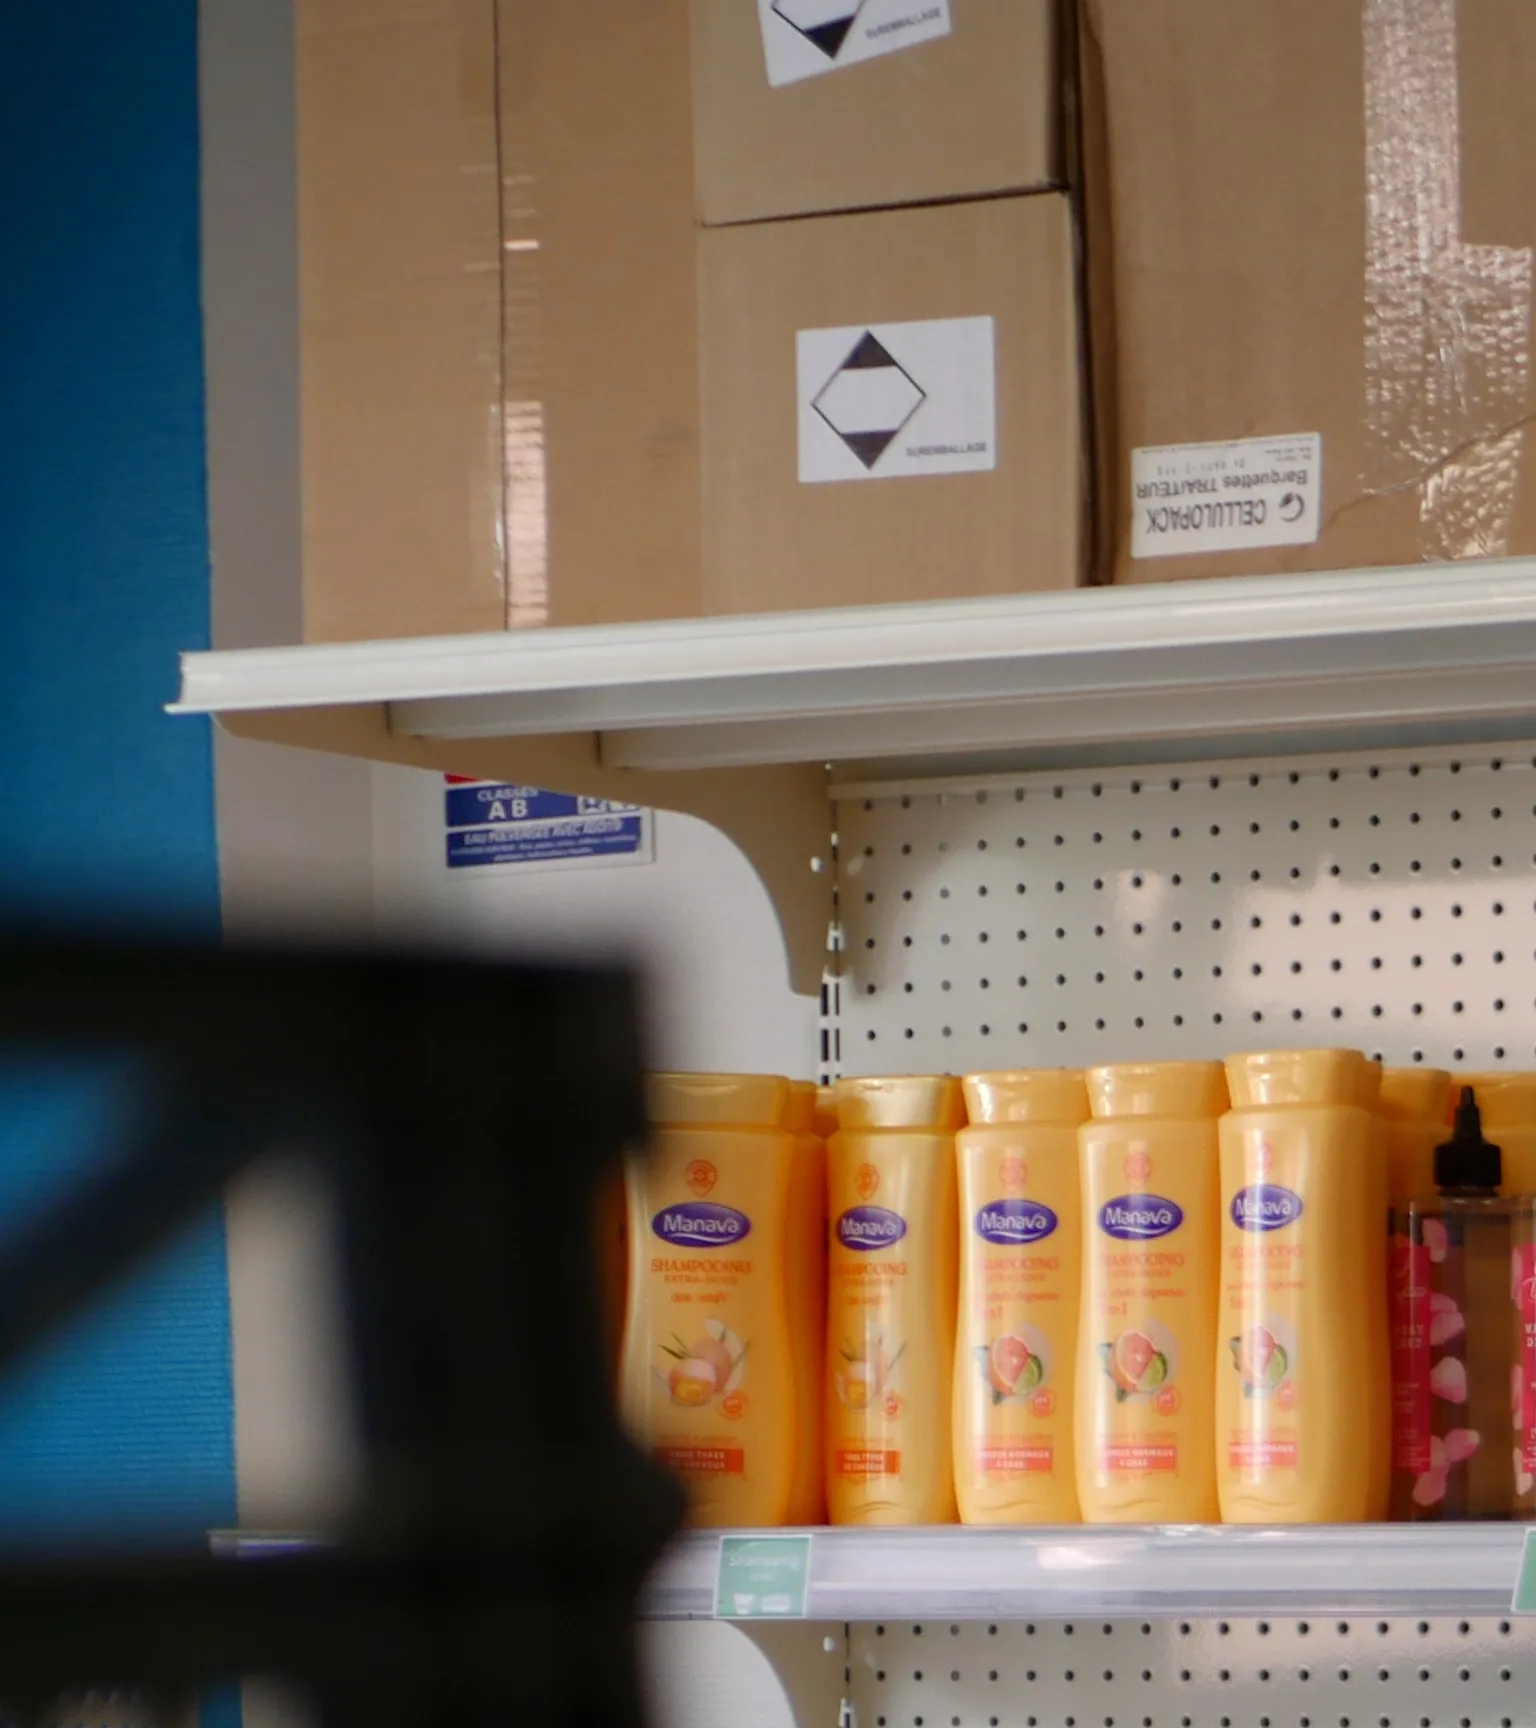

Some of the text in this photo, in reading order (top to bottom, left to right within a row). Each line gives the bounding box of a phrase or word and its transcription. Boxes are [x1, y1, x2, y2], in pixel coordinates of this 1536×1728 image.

[1136, 469, 1307, 498] Barquettes TRAITEUR
[1146, 499, 1266, 533] CELLULOPACK
[488, 799, 527, 820] A B
[1236, 1198, 1292, 1216] Manava
[663, 1214, 740, 1233] Manava
[840, 1217, 899, 1237] Manava
[980, 1211, 1048, 1231] Manava
[1104, 1207, 1174, 1228] Manava
